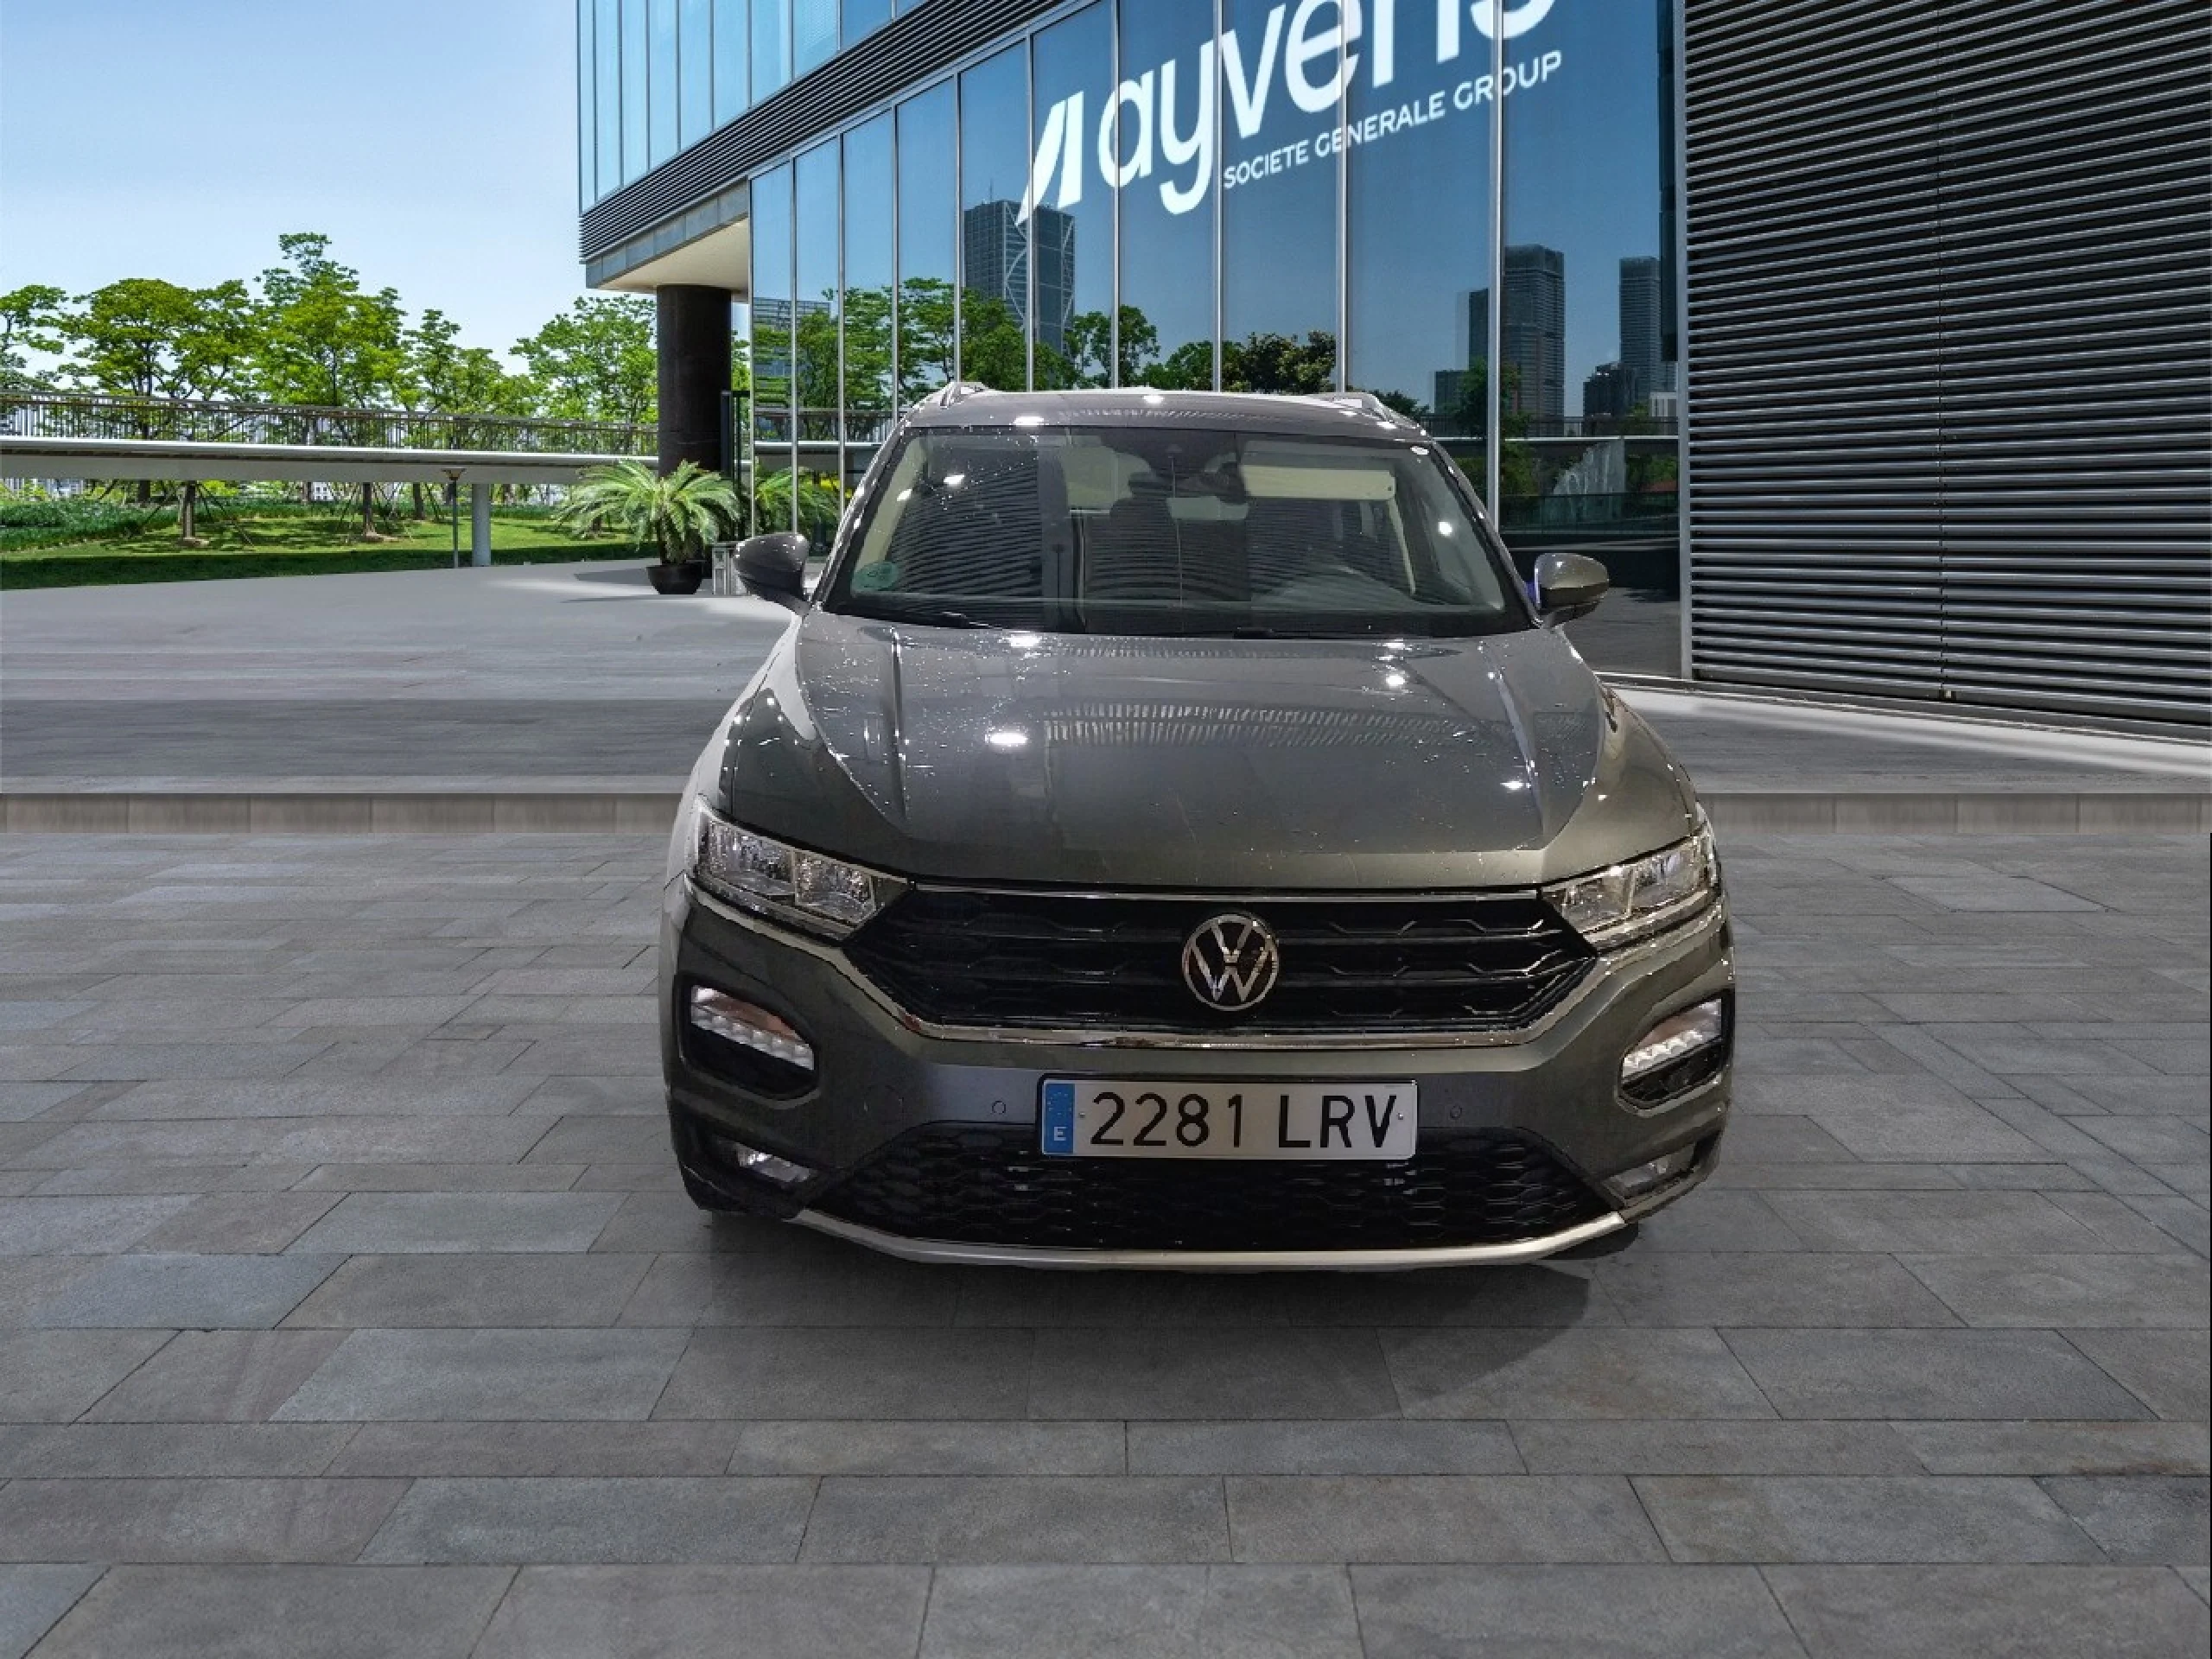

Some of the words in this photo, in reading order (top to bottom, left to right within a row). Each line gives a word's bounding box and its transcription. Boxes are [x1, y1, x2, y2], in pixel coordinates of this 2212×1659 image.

[1224, 139, 1310, 189] SOCIETE
[1314, 90, 1446, 158] GENERALE
[1453, 49, 1562, 111] GROUP
[1053, 1126, 1067, 1141] E
[1090, 1091, 1243, 1147] 2281
[1278, 1094, 1397, 1148] LRV
